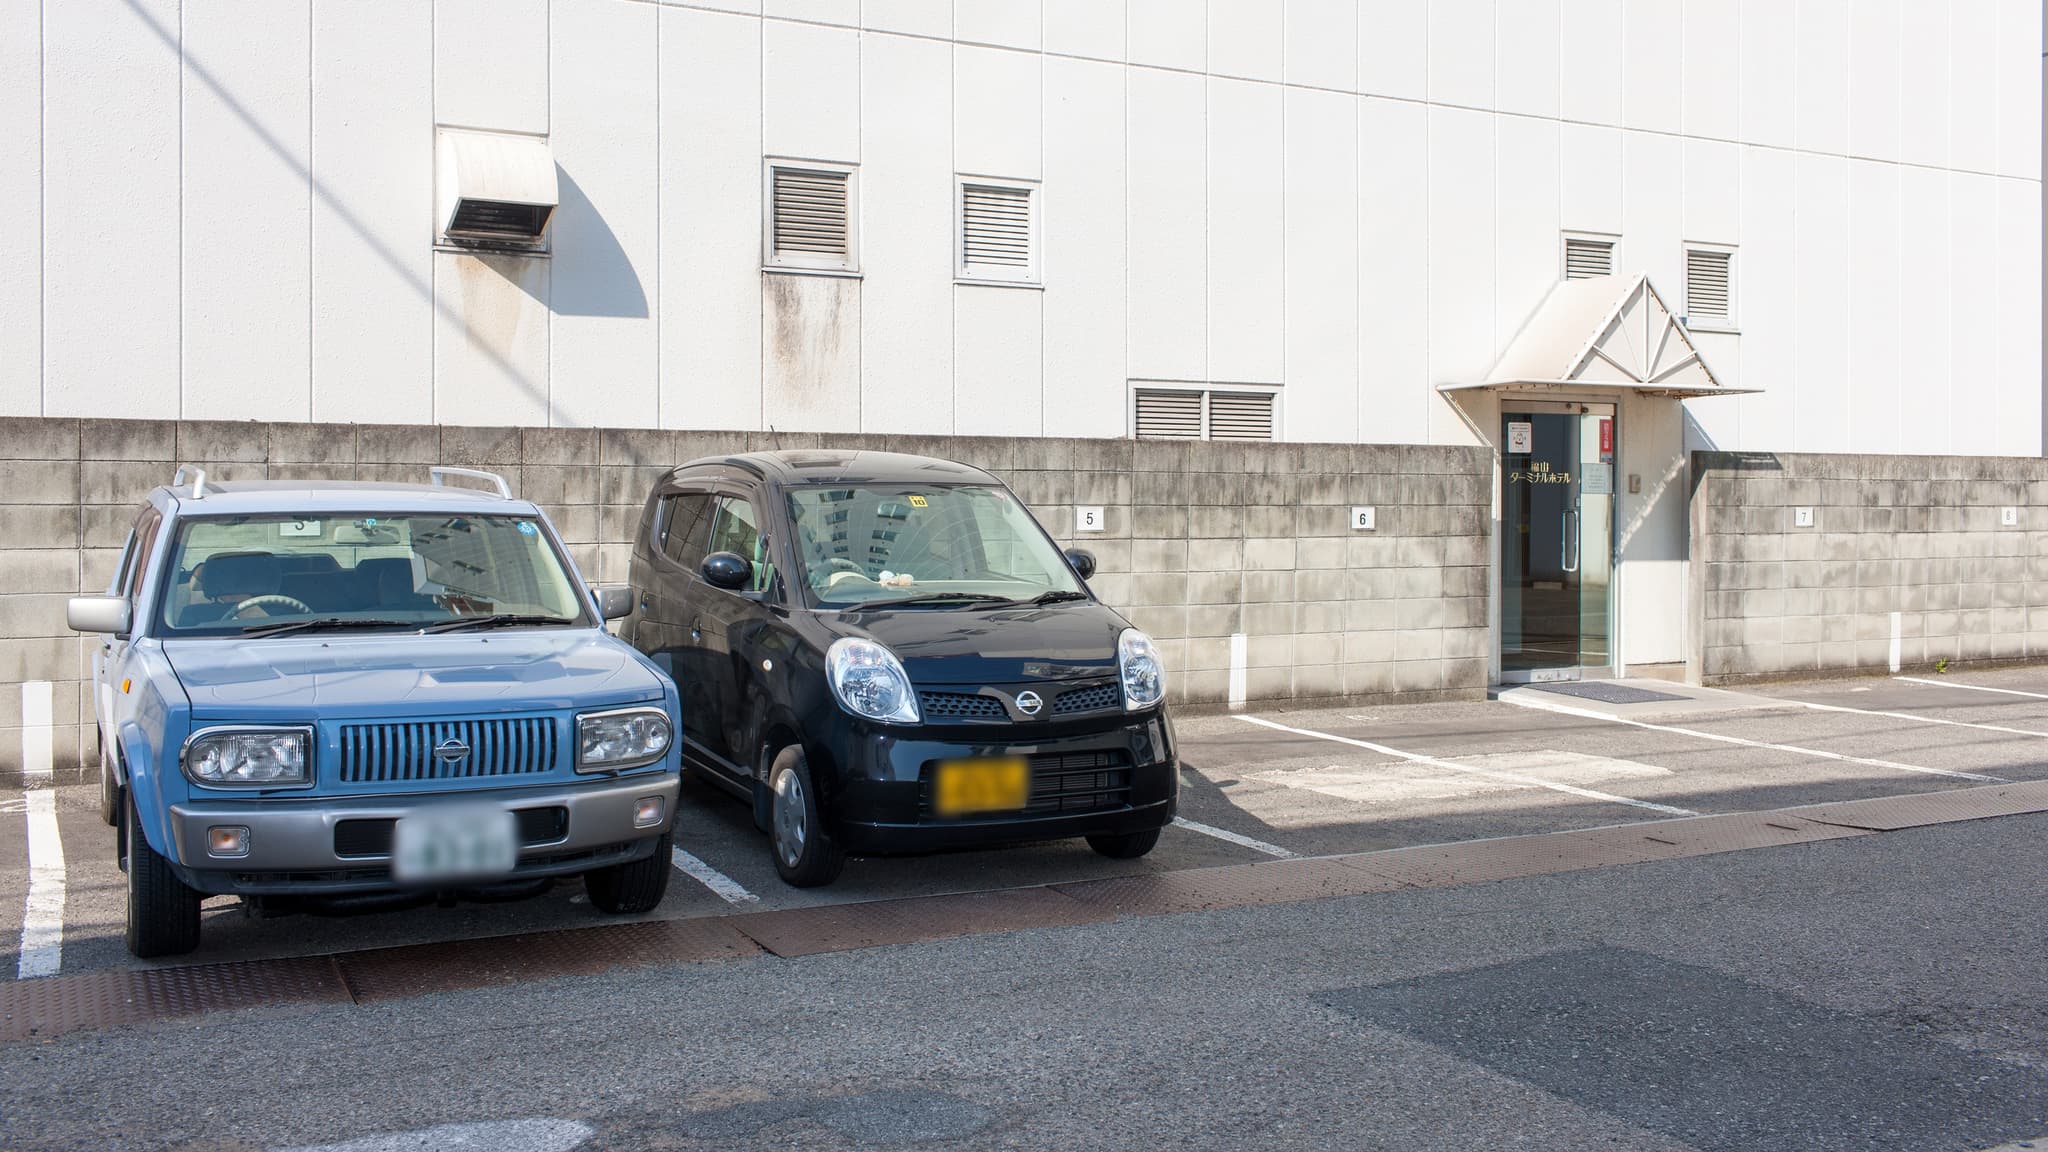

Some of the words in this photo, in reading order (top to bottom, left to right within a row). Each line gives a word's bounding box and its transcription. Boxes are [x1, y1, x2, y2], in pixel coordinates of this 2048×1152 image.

[1510, 472, 1571, 484] ターミナルホテル
[1086, 512, 1094, 525] 5
[1359, 512, 1366, 525] 6
[1801, 511, 1807, 522] 7
